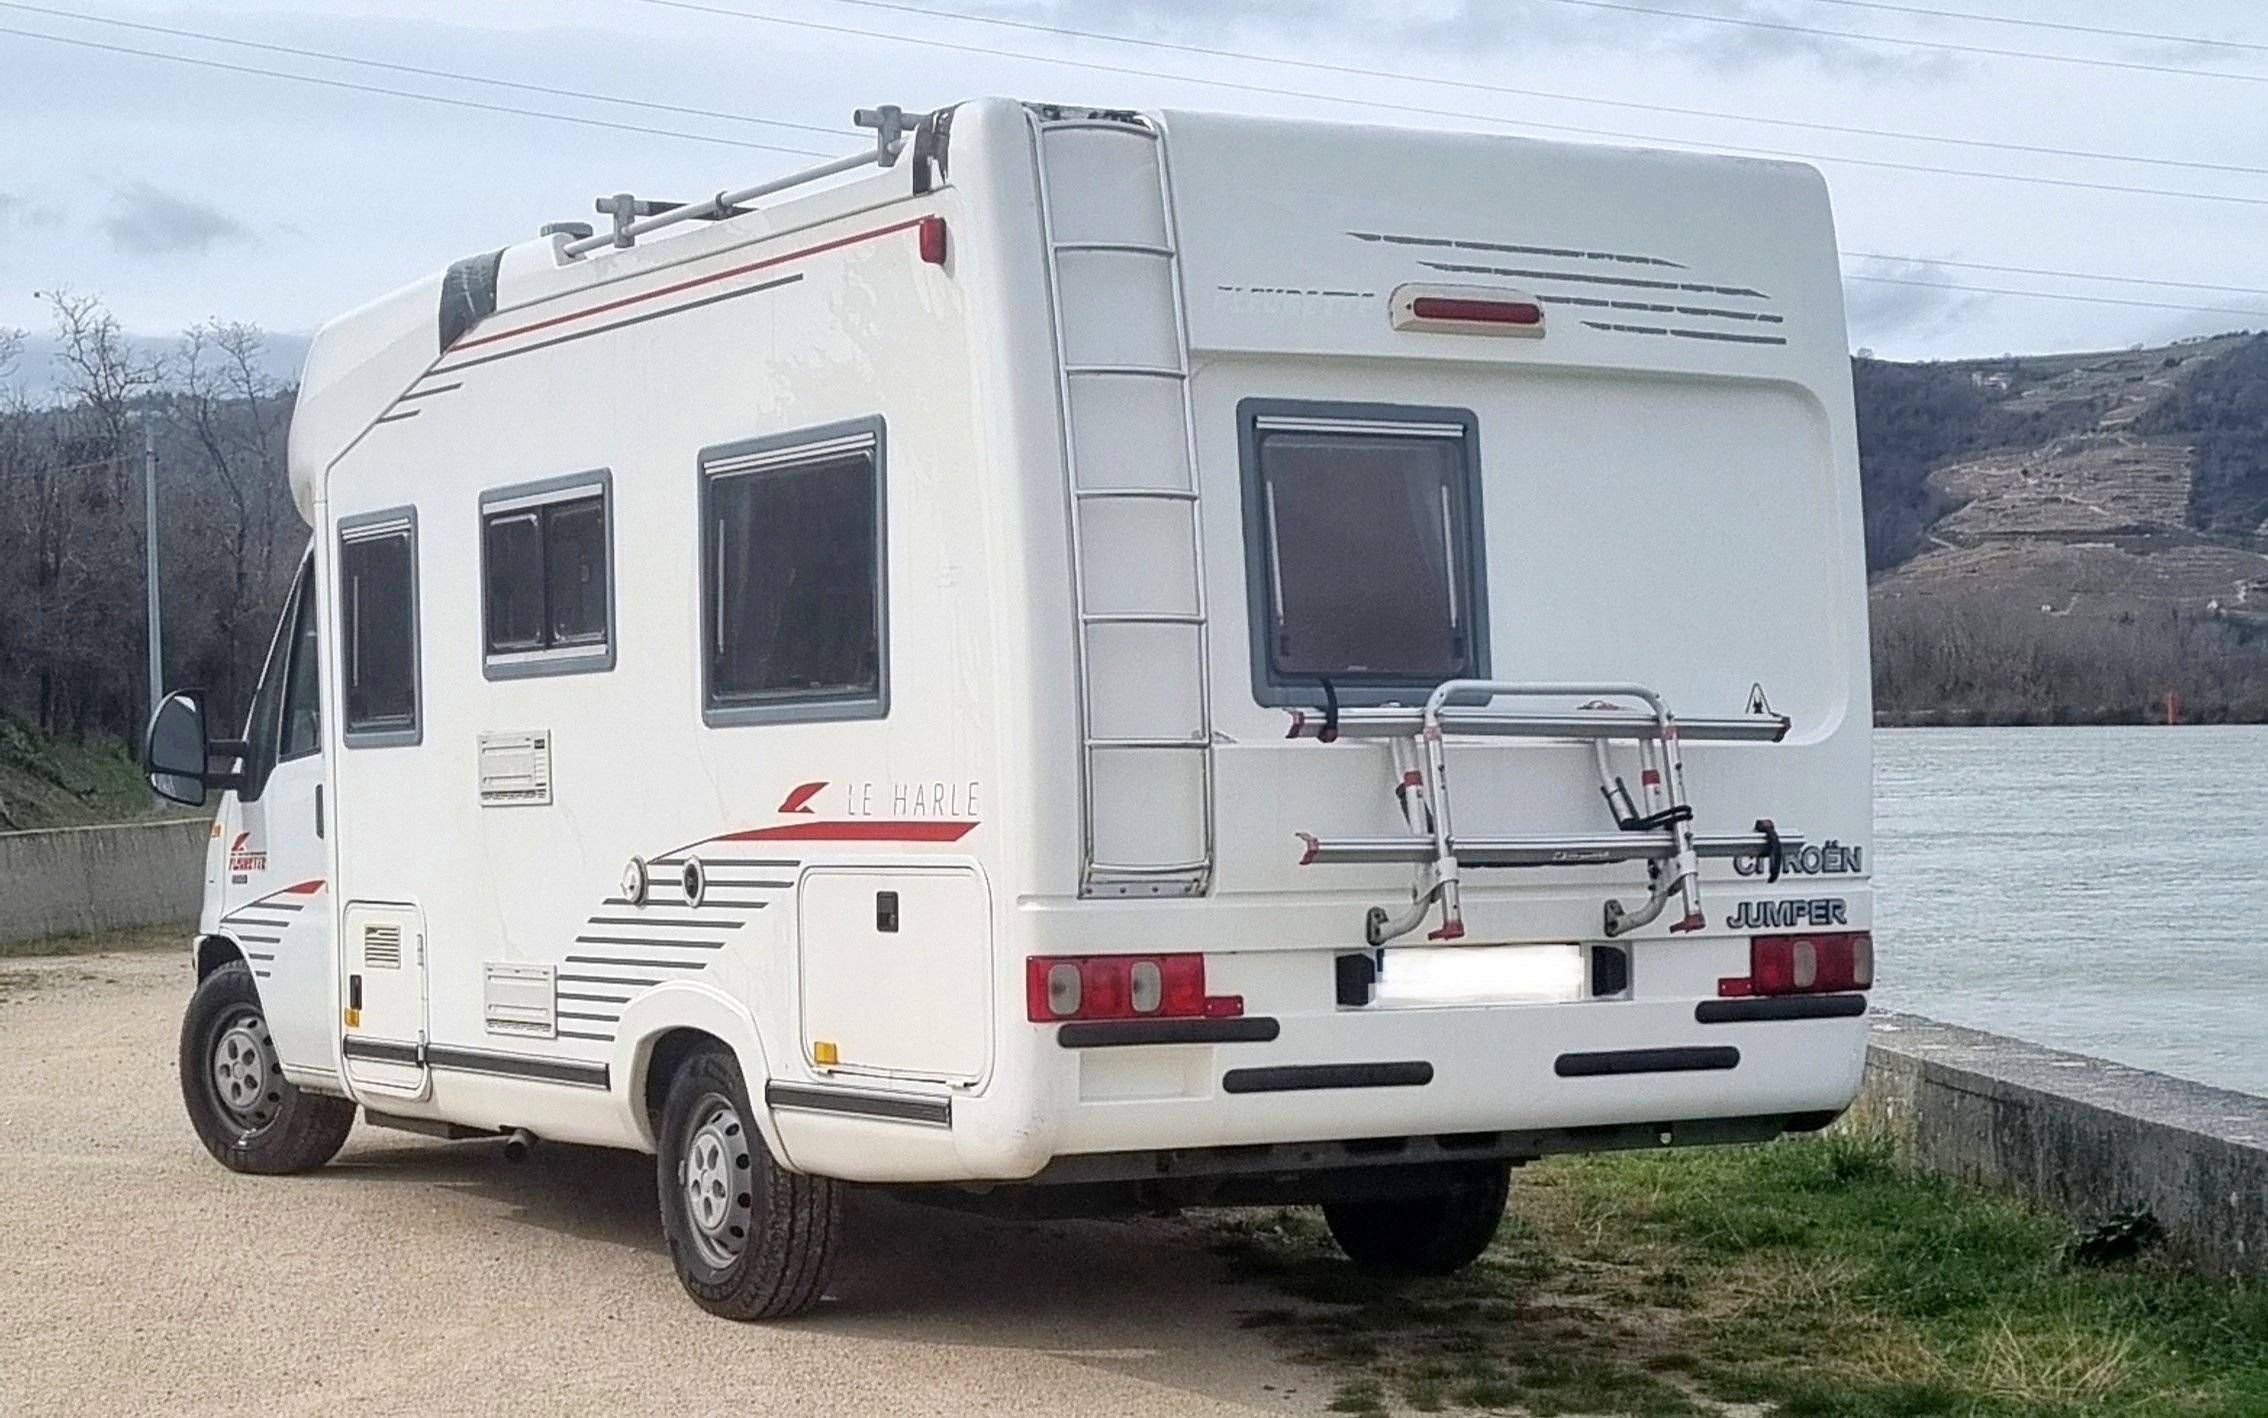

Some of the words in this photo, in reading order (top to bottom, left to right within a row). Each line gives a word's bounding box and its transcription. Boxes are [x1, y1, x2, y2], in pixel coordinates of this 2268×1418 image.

[848, 783, 873, 816] LE
[893, 782, 979, 816] HARLE
[1733, 840, 1862, 876] CIROËN
[1726, 898, 1847, 929] JUMPER
